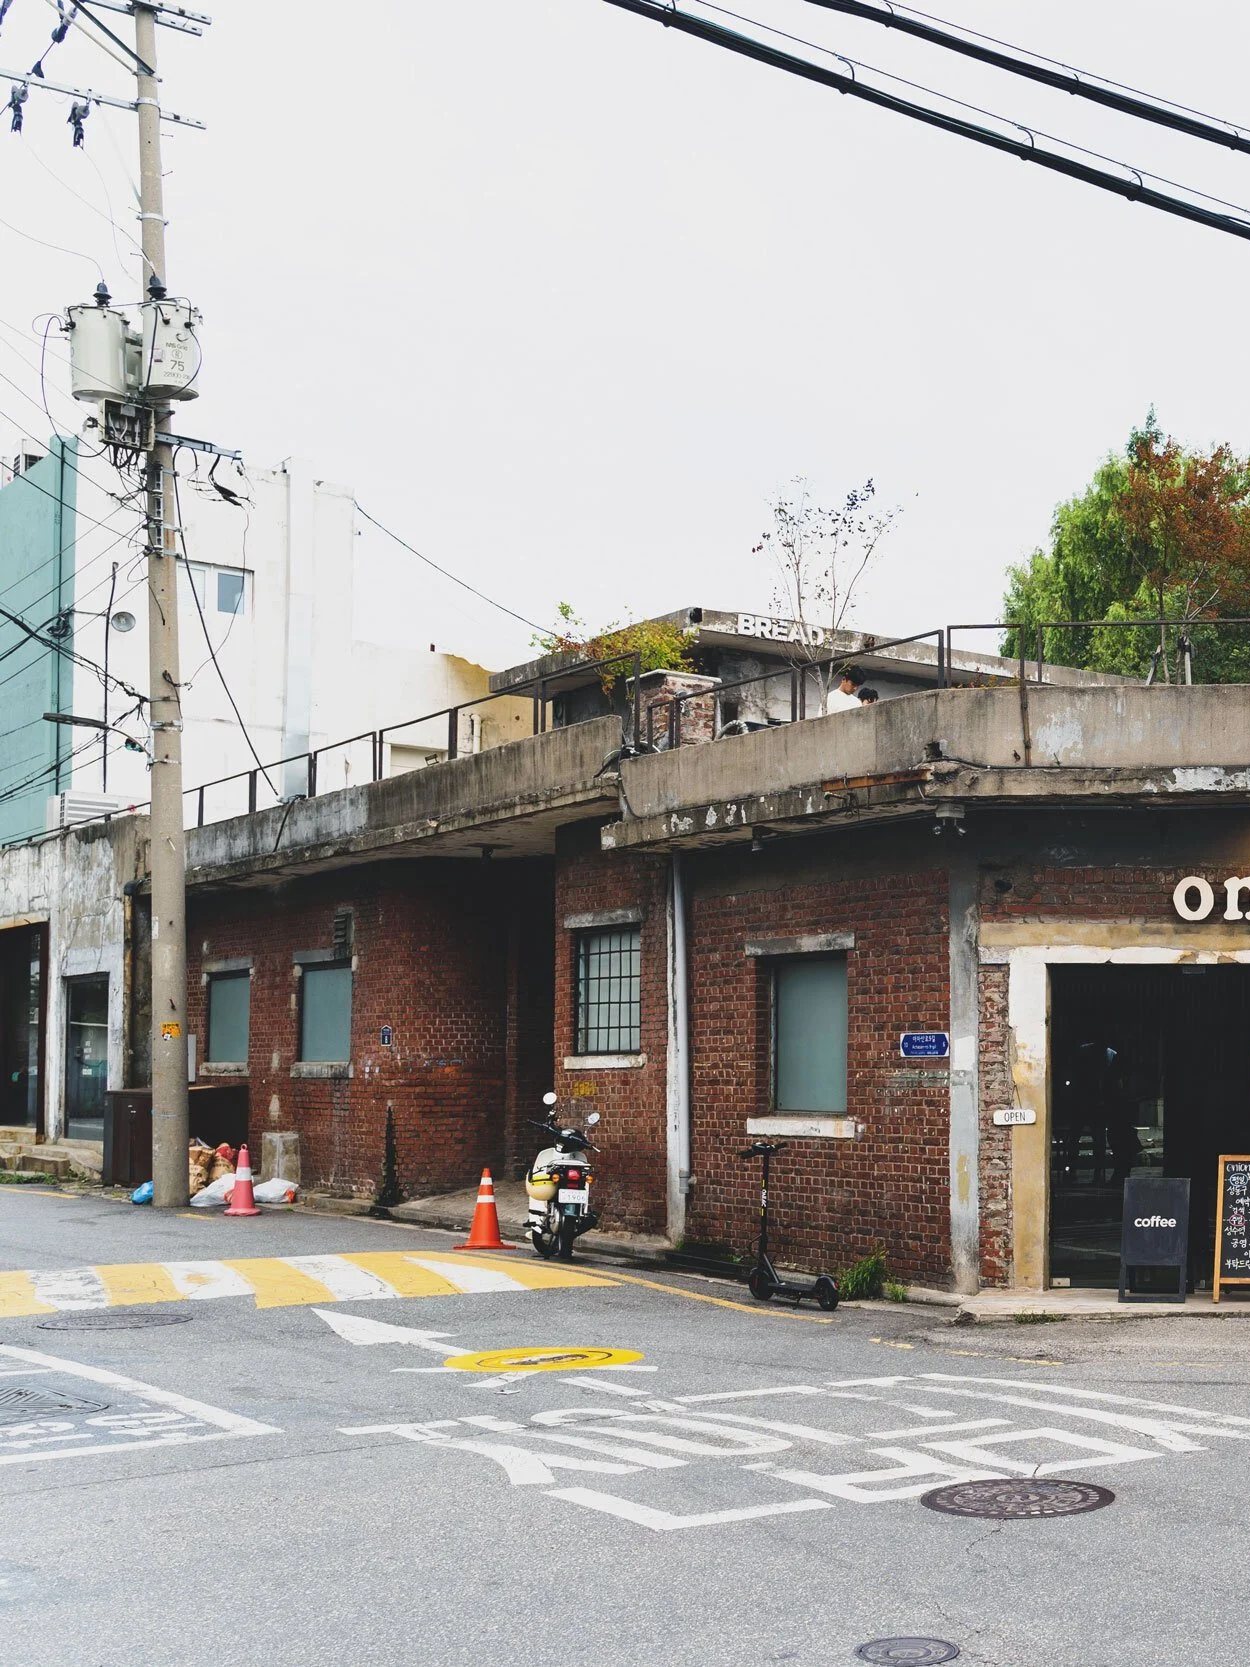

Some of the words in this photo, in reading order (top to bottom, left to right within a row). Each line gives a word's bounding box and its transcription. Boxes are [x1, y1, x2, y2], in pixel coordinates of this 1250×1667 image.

[170, 360, 185, 372] 75
[737, 613, 824, 646] BREAD
[1004, 1112, 1026, 1123] OPEN
[1134, 1215, 1177, 1228] coffee
[1224, 1226, 1246, 1237] 성수역
[1231, 1238, 1248, 1249] 공영
